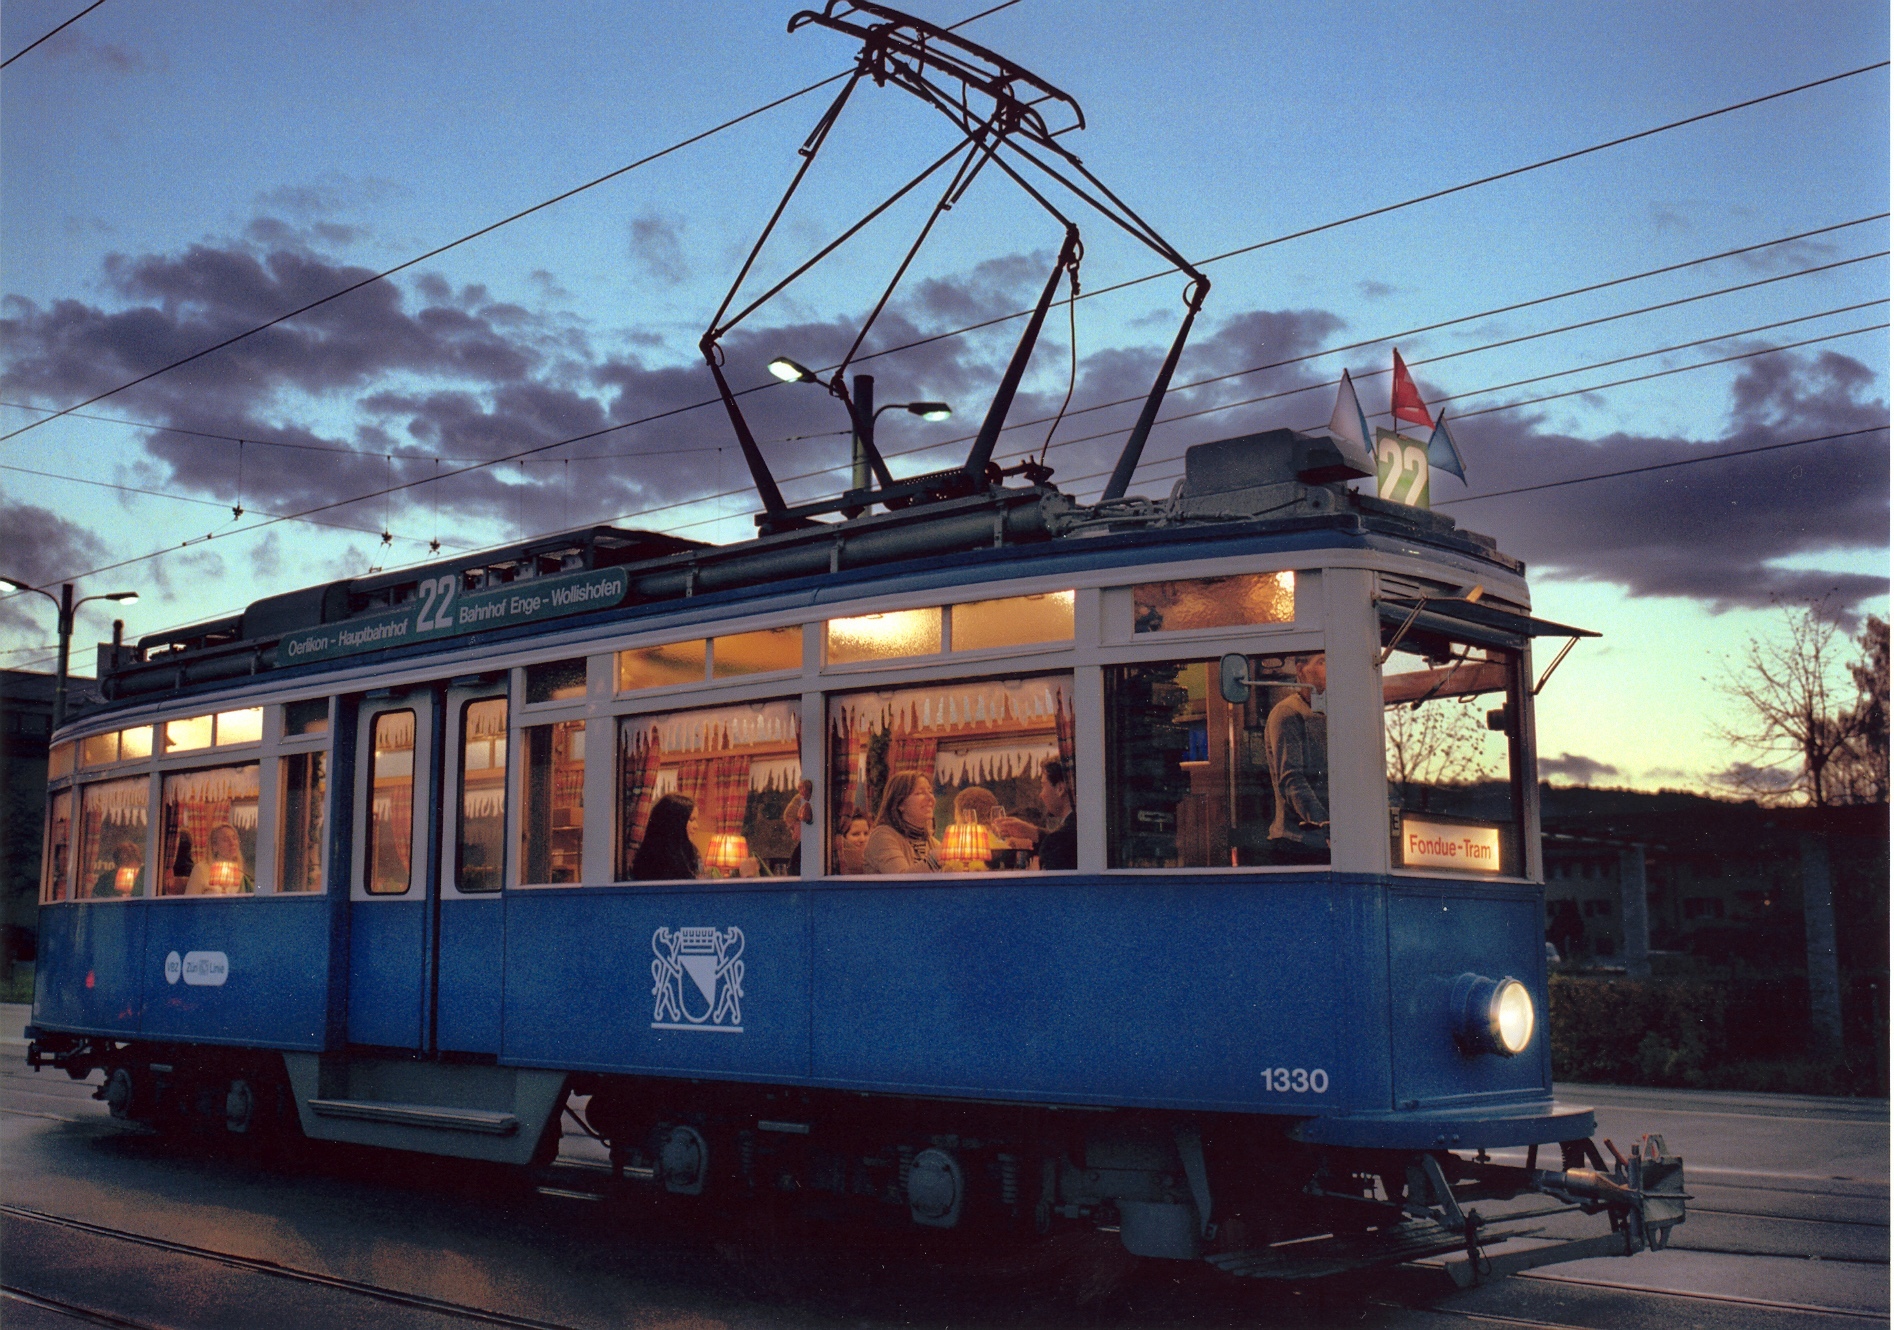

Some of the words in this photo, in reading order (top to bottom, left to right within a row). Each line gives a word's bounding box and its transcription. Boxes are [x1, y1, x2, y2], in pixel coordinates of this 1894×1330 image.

[1379, 437, 1428, 506] 22
[288, 636, 329, 657] Oerlikon
[338, 618, 408, 647] Hauptbahnhof
[416, 574, 456, 633] 22
[459, 598, 507, 625] Bahnhof
[510, 594, 541, 616] Enge
[551, 577, 621, 607] Wollishofen
[1409, 834, 1492, 860] Fondue-Tram
[1260, 1067, 1329, 1094] 1330
